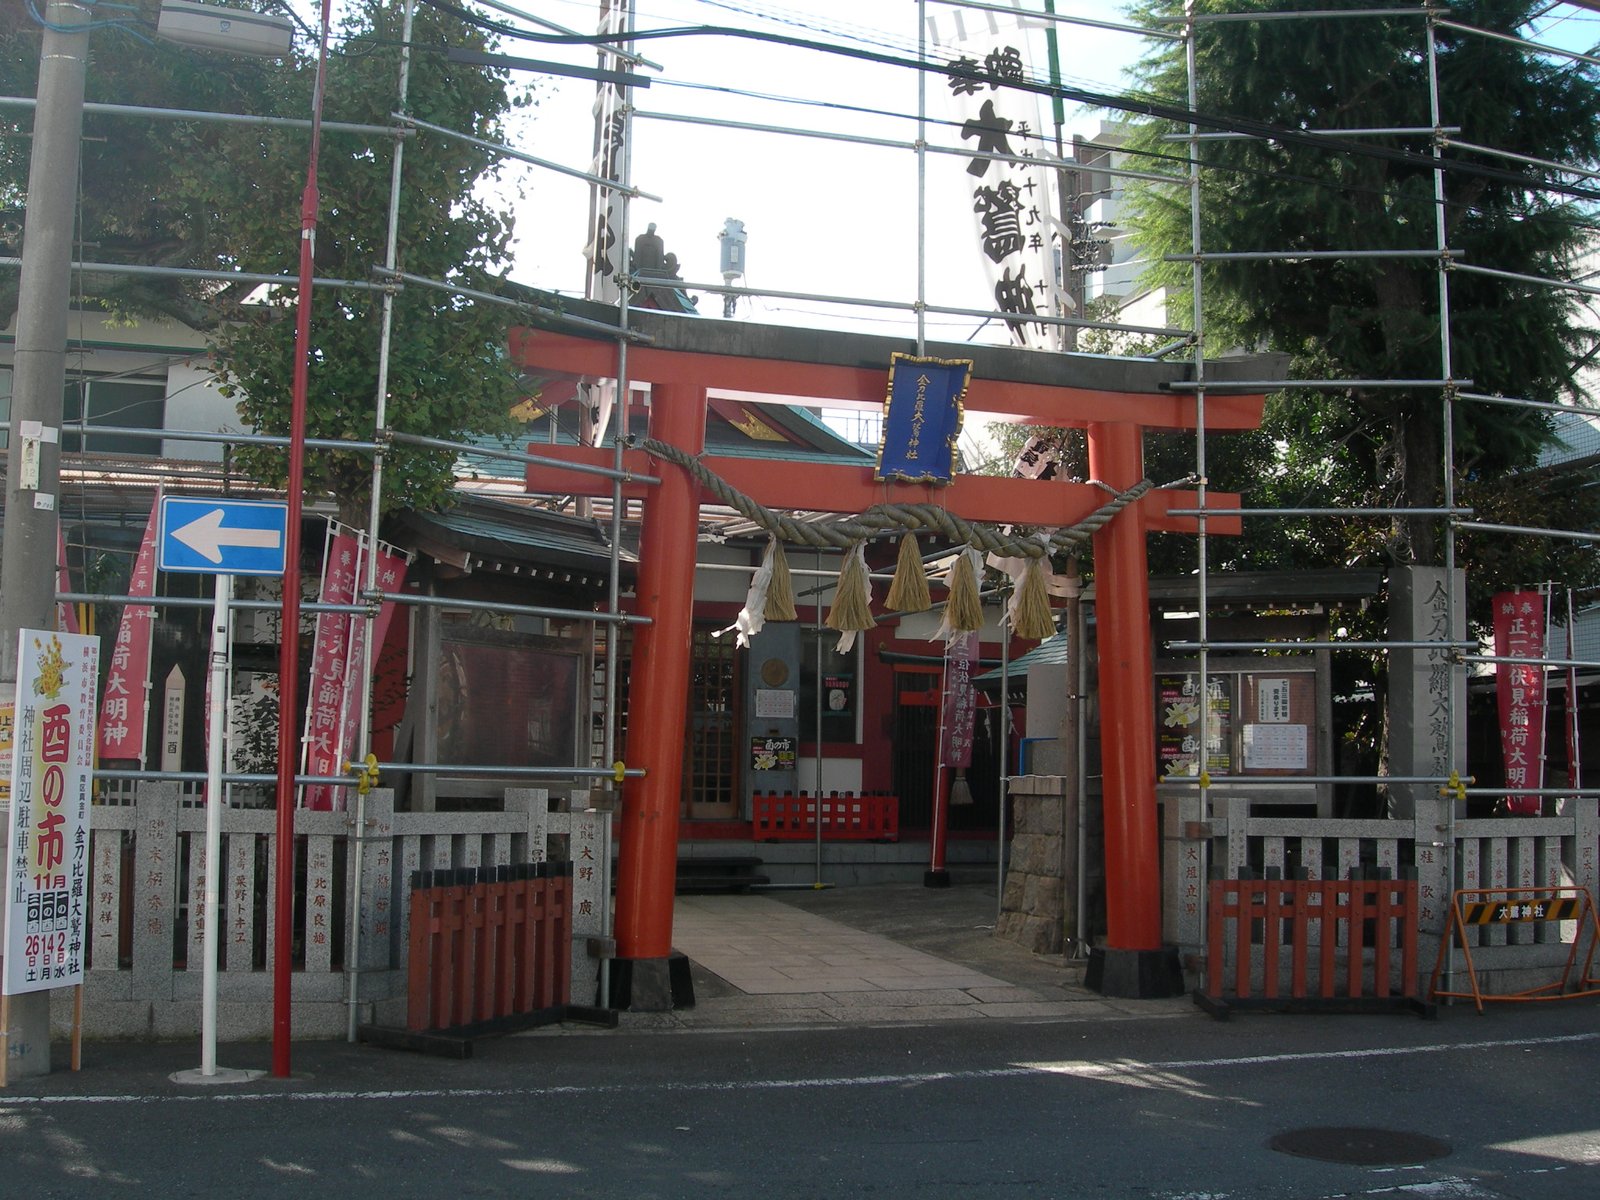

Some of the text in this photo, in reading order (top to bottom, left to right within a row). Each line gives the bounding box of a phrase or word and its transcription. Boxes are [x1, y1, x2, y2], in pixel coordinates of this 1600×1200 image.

[13, 704, 35, 904] 神社周辺駐車禁止
[37, 703, 71, 870] 酉の市
[33, 873, 66, 891] 11月
[68, 825, 86, 976] 金刀比羅大鷲神社
[313, 877, 327, 944] 北原良雄
